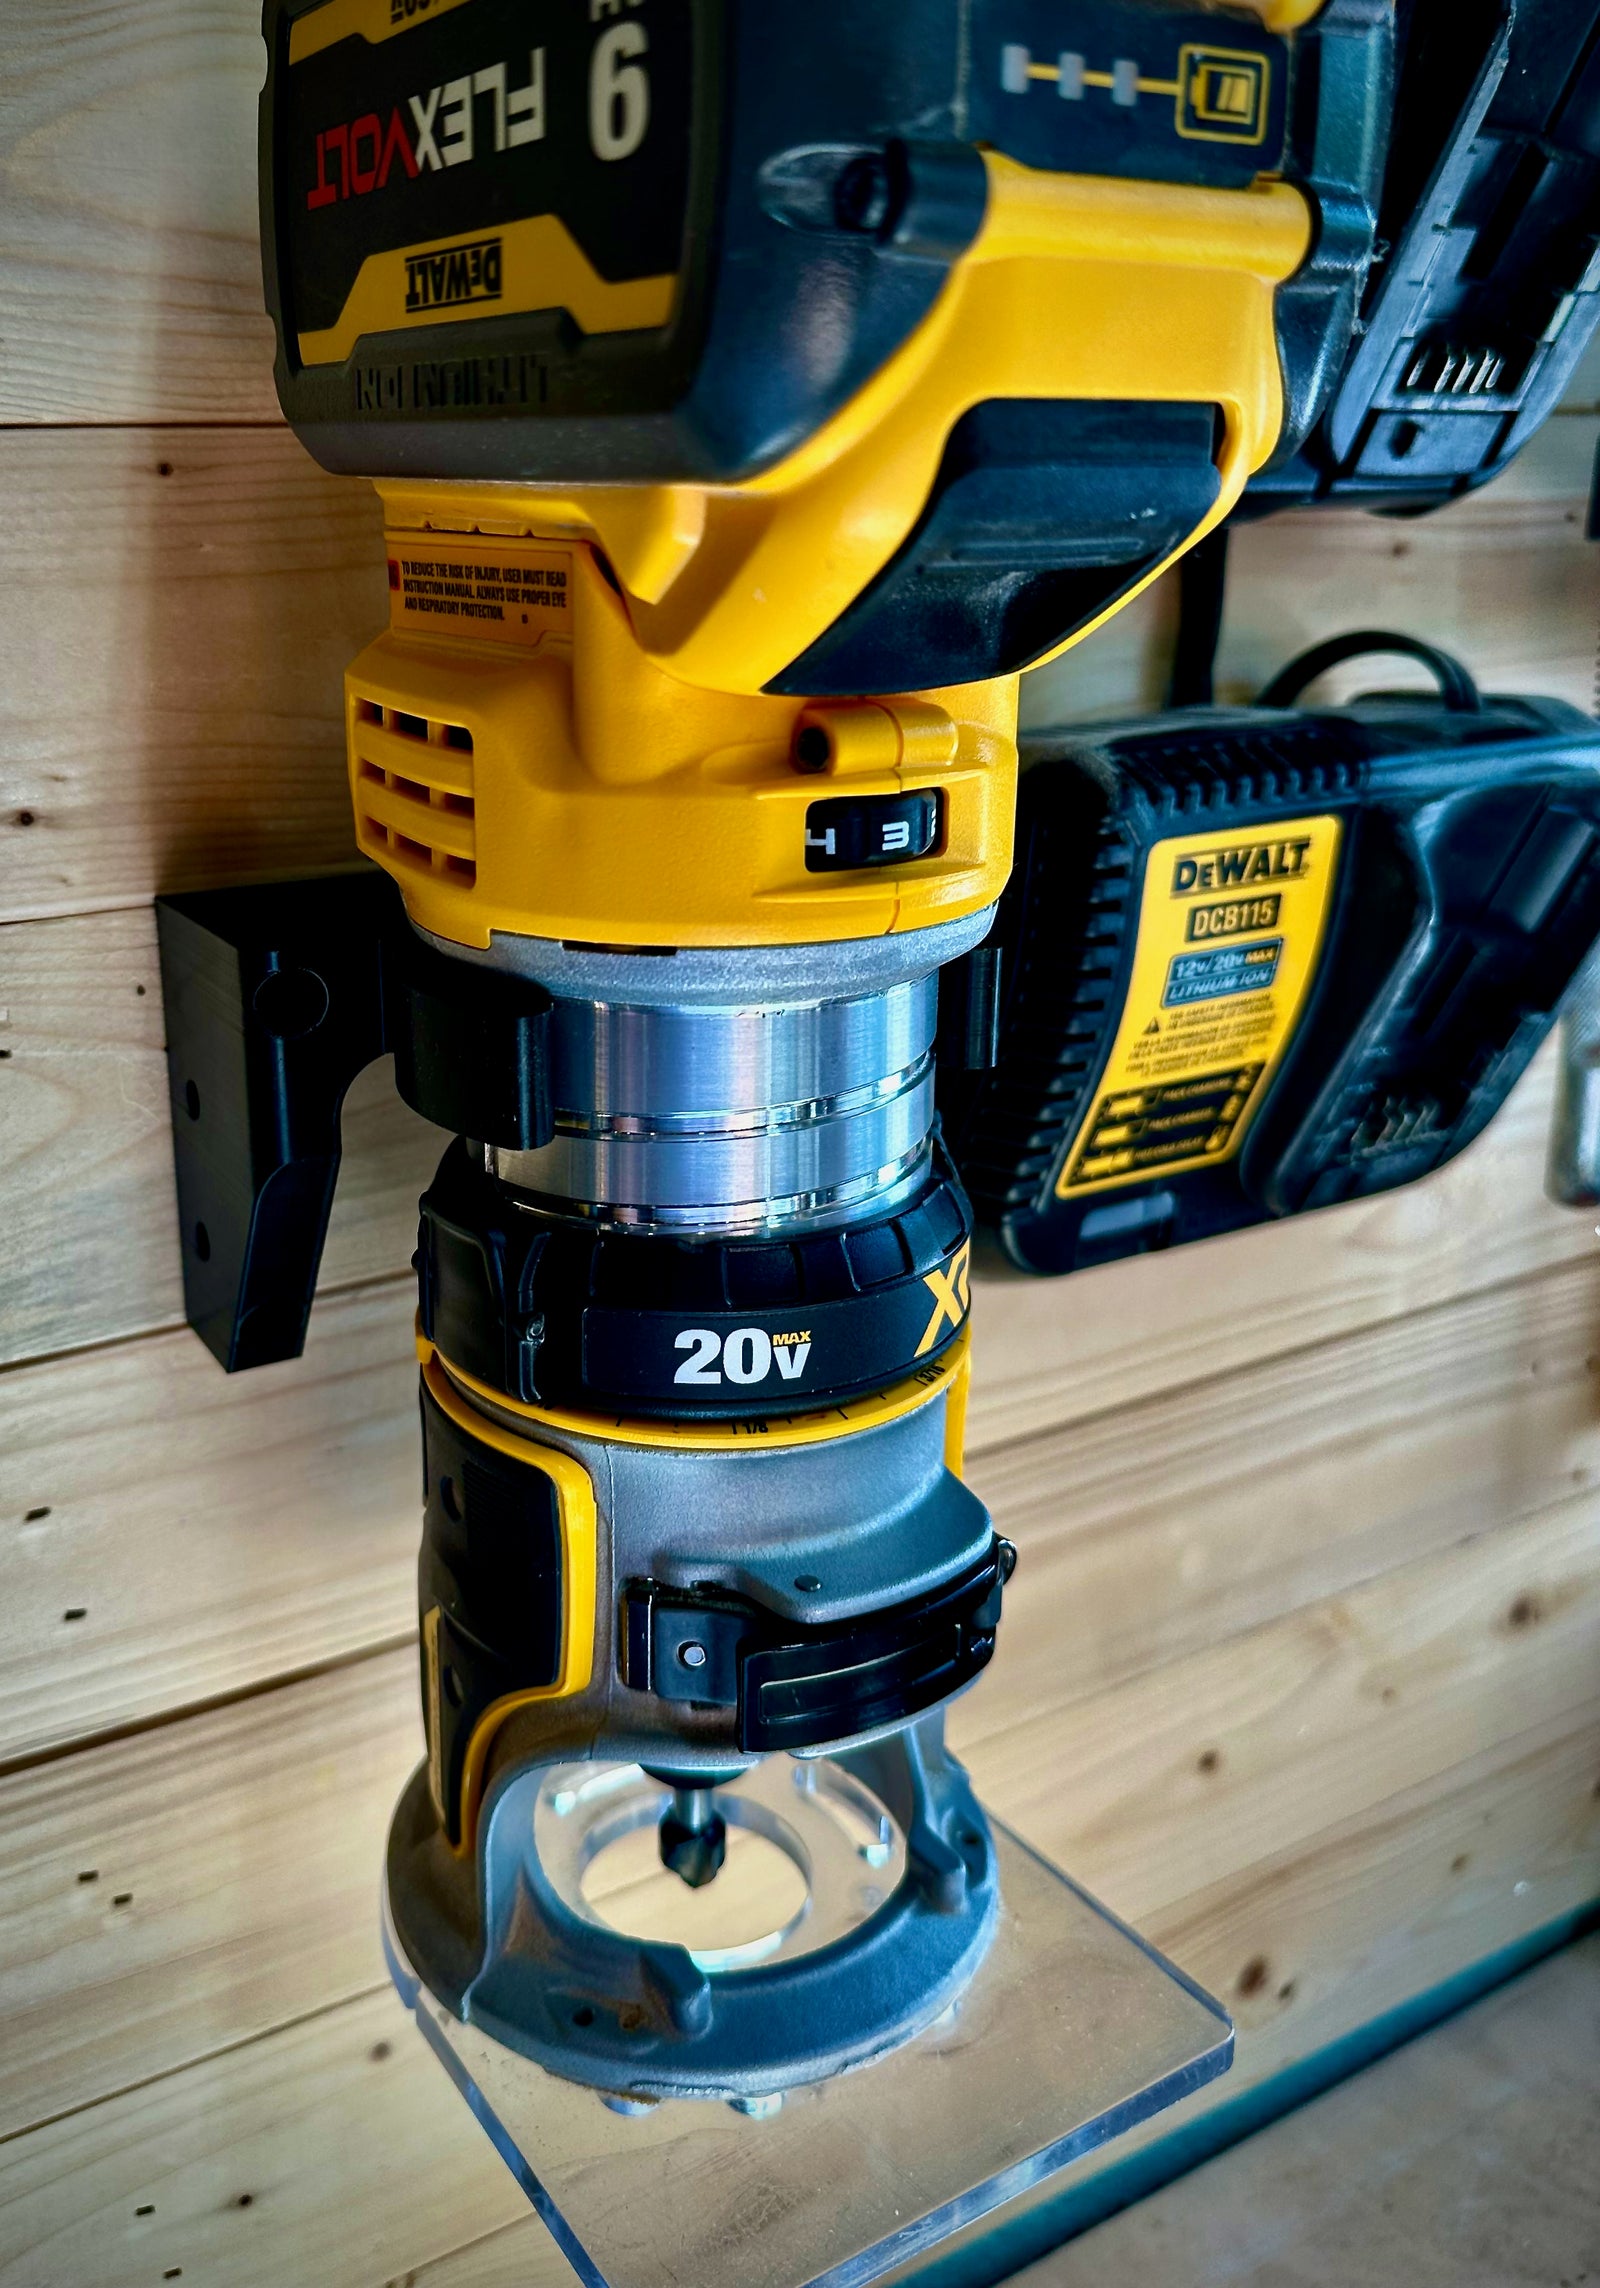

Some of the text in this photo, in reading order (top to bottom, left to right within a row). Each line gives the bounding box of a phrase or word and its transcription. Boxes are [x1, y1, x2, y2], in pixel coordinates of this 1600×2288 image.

[589, 20, 650, 163] 9
[308, 47, 546, 211] FLEXVOLT
[402, 560, 410, 574] TO
[411, 561, 435, 577] REDUCE
[435, 563, 447, 578] THE
[449, 564, 463, 579] RISK
[465, 565, 474, 580] OF
[475, 566, 502, 583] INJURY,
[503, 568, 522, 583] USER
[523, 569, 545, 586] MUST
[546, 570, 567, 588] READ
[403, 579, 444, 595] INSTRUCTION
[477, 585, 505, 602] ALWAYS
[506, 588, 520, 603] USE
[521, 589, 551, 607] PROPER
[552, 591, 567, 608] EYE
[405, 597, 417, 611] AND
[418, 598, 459, 615] RESPIRATORY
[461, 602, 505, 620] PROTECTION.
[805, 828, 836, 855] 4
[882, 820, 910, 851] 3
[1193, 898, 1274, 938] DCB115
[1245, 948, 1274, 964] MAX
[1169, 969, 1271, 1000] LITHIUM ION
[773, 1330, 812, 1346] MAX
